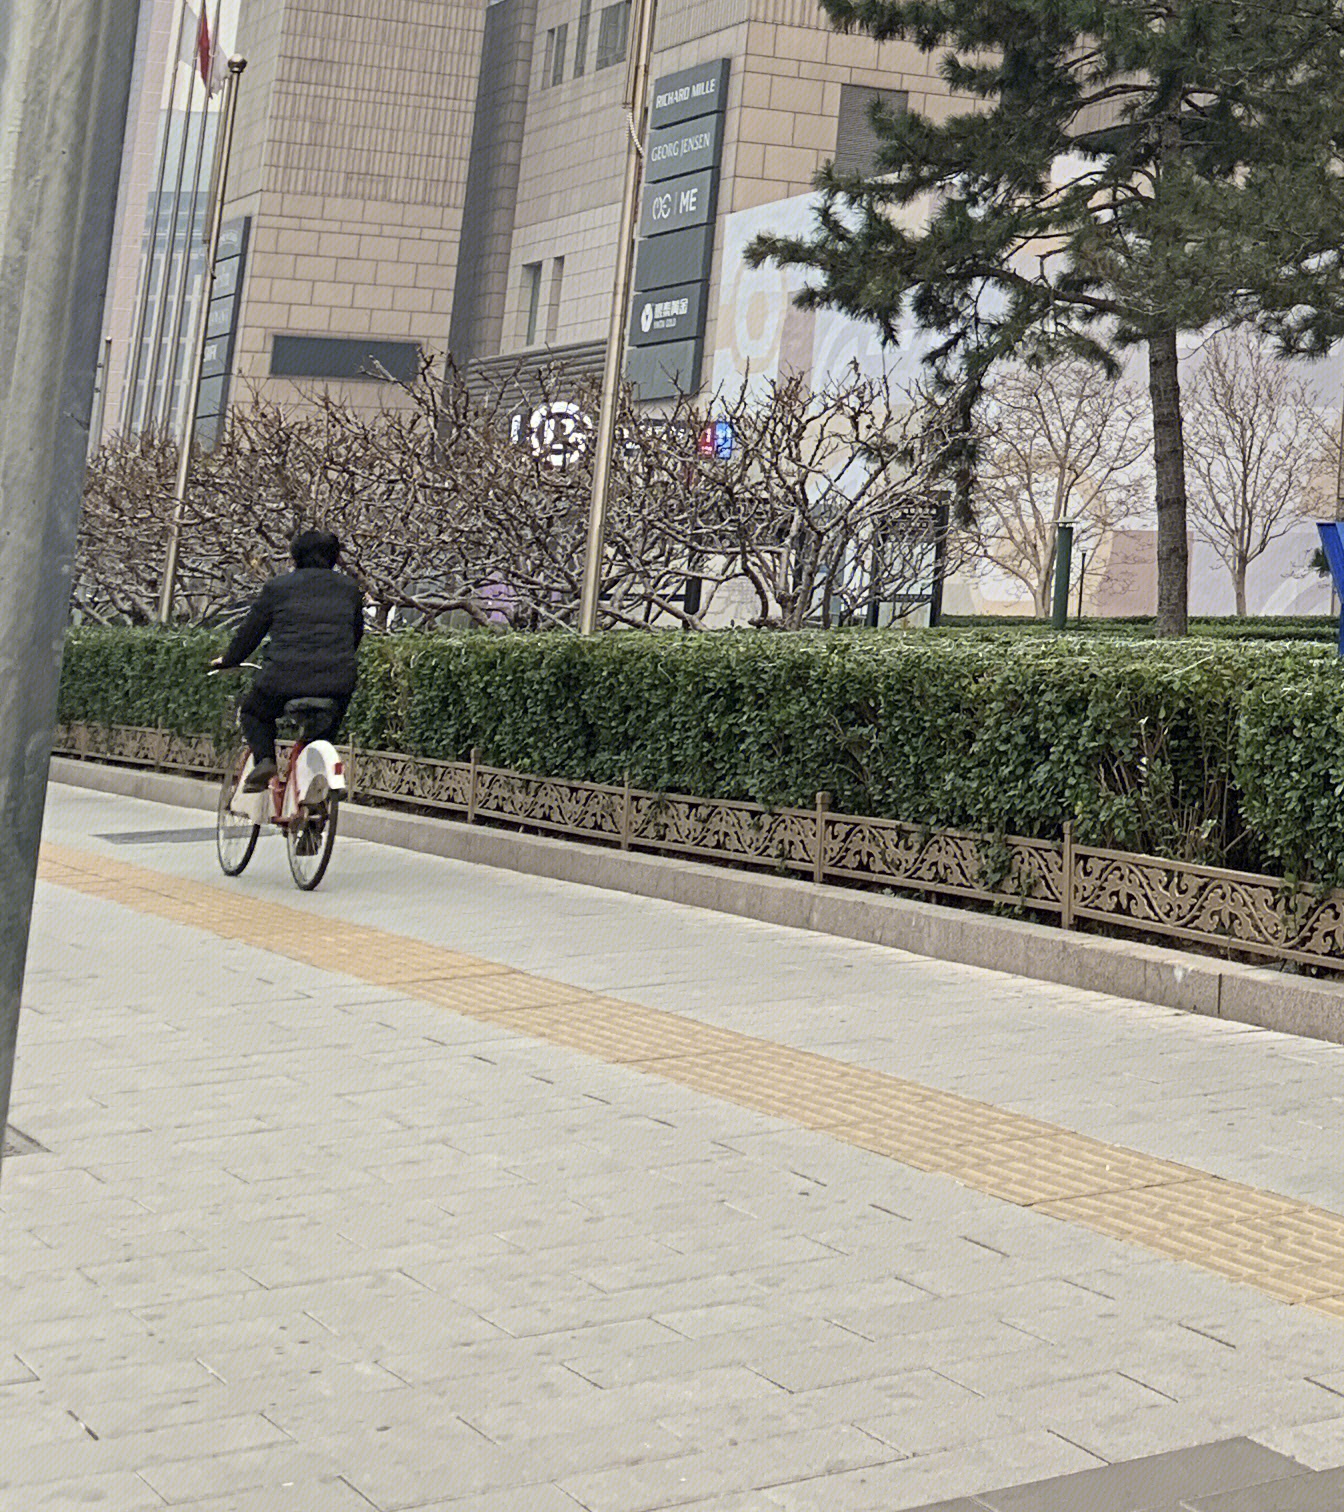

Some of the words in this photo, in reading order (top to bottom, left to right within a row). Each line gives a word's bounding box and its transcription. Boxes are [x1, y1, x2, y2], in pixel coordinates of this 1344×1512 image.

[655, 87, 690, 109] RICHARD
[691, 78, 716, 98] MILLE
[651, 140, 680, 162] GEORG
[680, 132, 711, 157] JENSEN
[679, 188, 698, 214] ME
